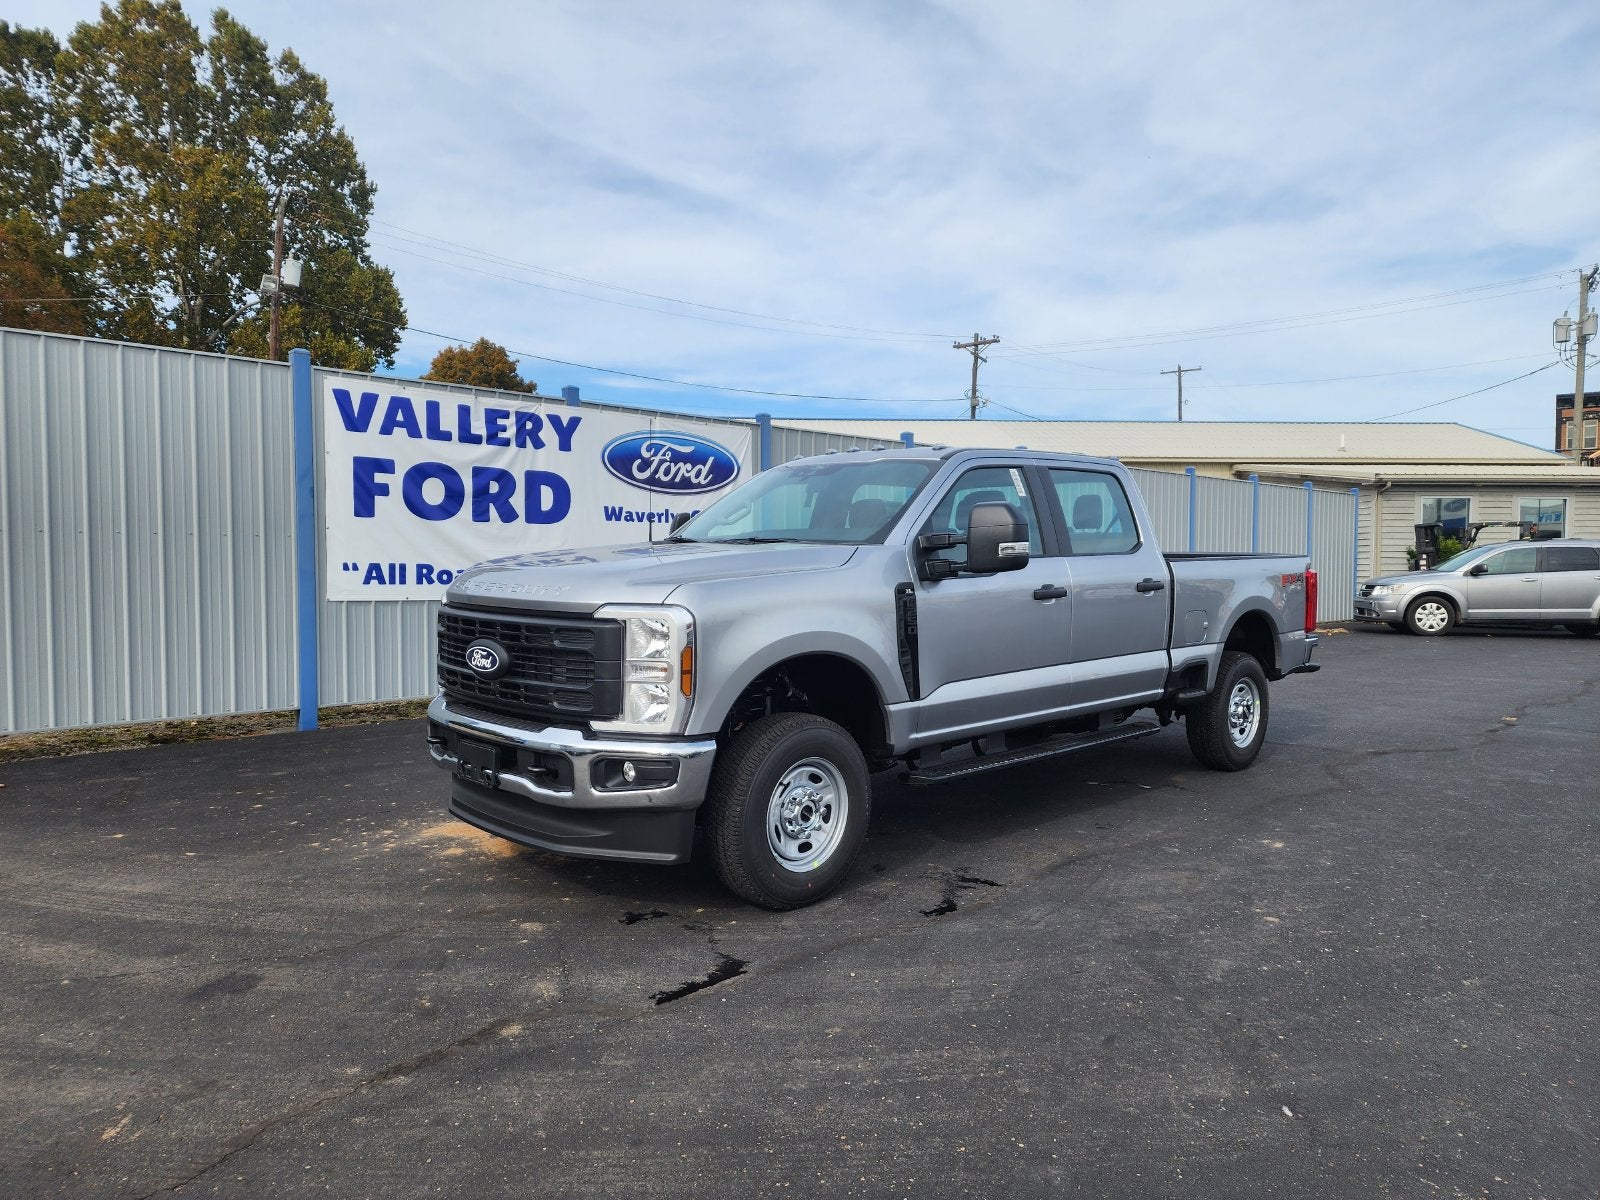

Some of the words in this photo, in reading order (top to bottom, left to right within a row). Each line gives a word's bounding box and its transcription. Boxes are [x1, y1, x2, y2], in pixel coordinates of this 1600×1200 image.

[332, 388, 582, 452] VALLERY
[632, 440, 715, 485] Ford
[353, 456, 571, 524] FORD
[511, 584, 570, 595] DUTY
[471, 649, 493, 669] Ford
